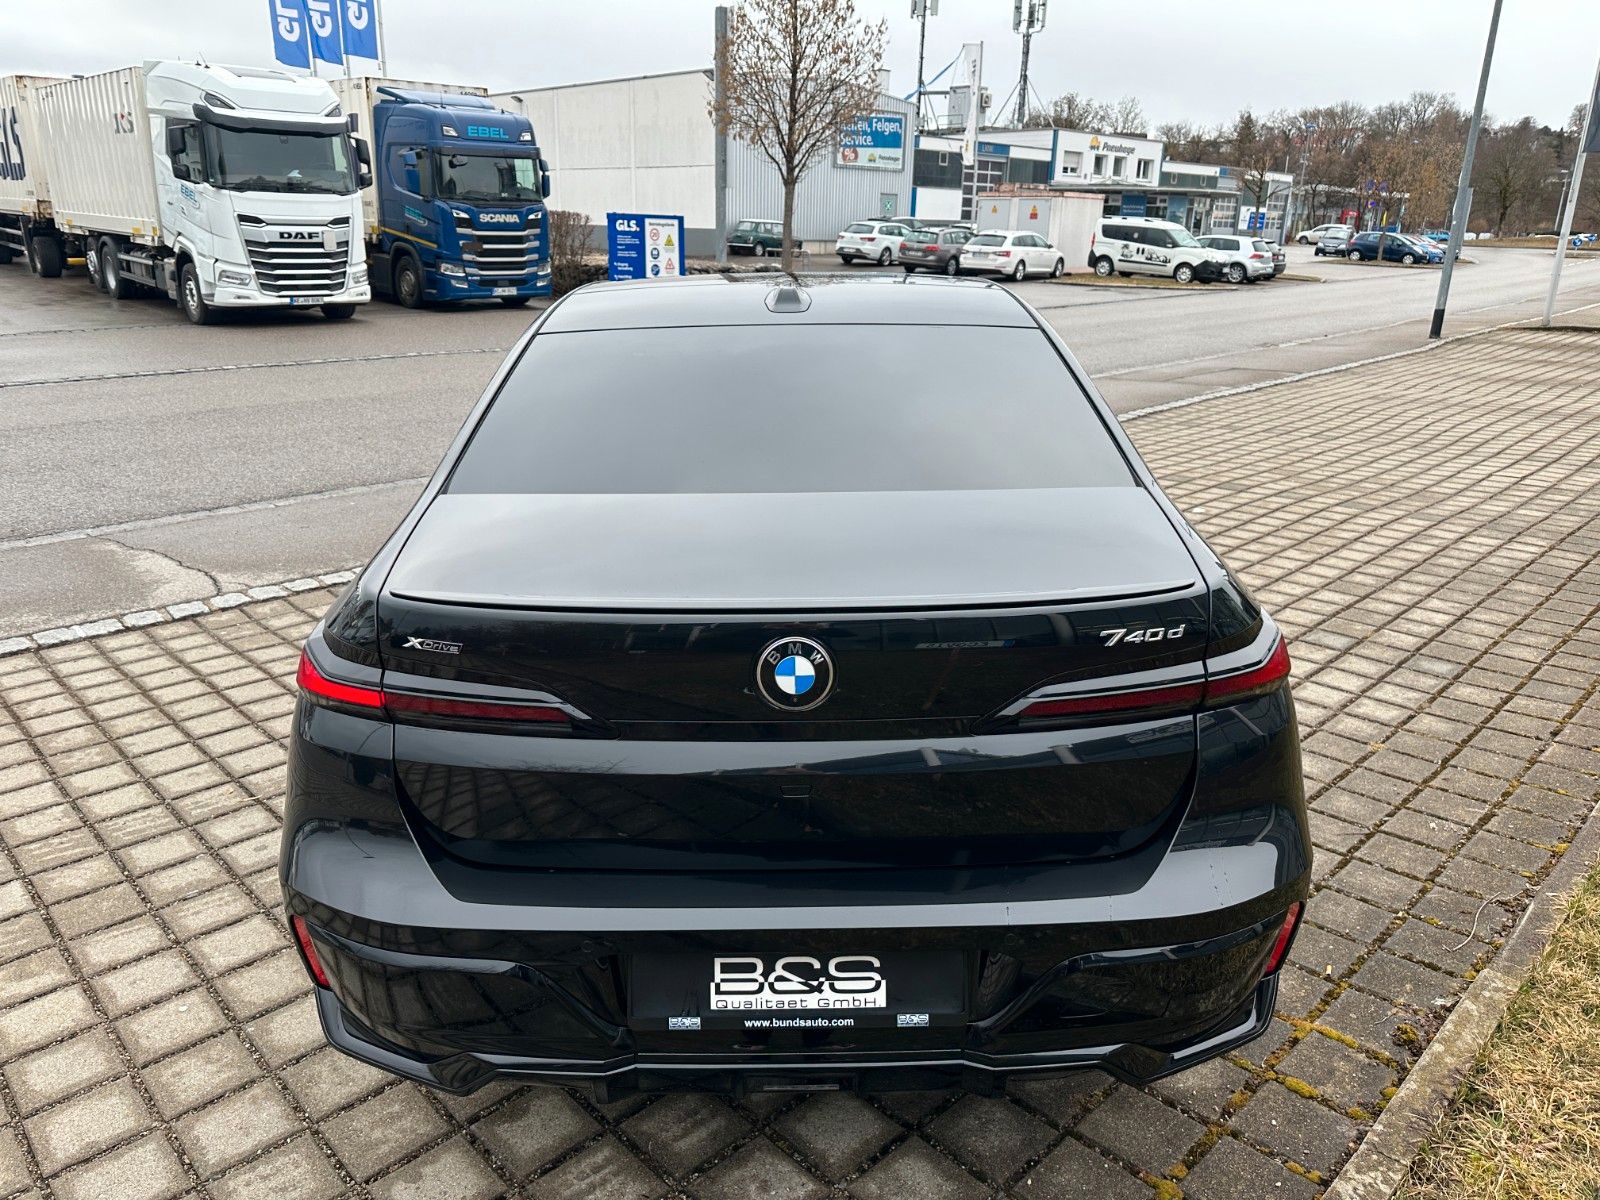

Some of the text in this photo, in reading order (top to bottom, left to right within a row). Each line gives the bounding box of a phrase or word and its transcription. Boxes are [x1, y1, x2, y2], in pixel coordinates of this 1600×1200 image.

[468, 125, 509, 139] EBEL
[873, 118, 902, 135] Felgen,
[840, 131, 874, 146] Service.
[480, 213, 520, 223] SCANIA
[615, 219, 640, 232] GLS.
[279, 231, 319, 240] DAF
[1100, 624, 1186, 647] 740d
[766, 642, 825, 665] BMW
[713, 955, 882, 996] B&S
[715, 996, 808, 1009] Qualitaet
[669, 1016, 701, 1029] B&S
[744, 1017, 855, 1028] www.bundsauto.com
[898, 1013, 928, 1025] B&S
